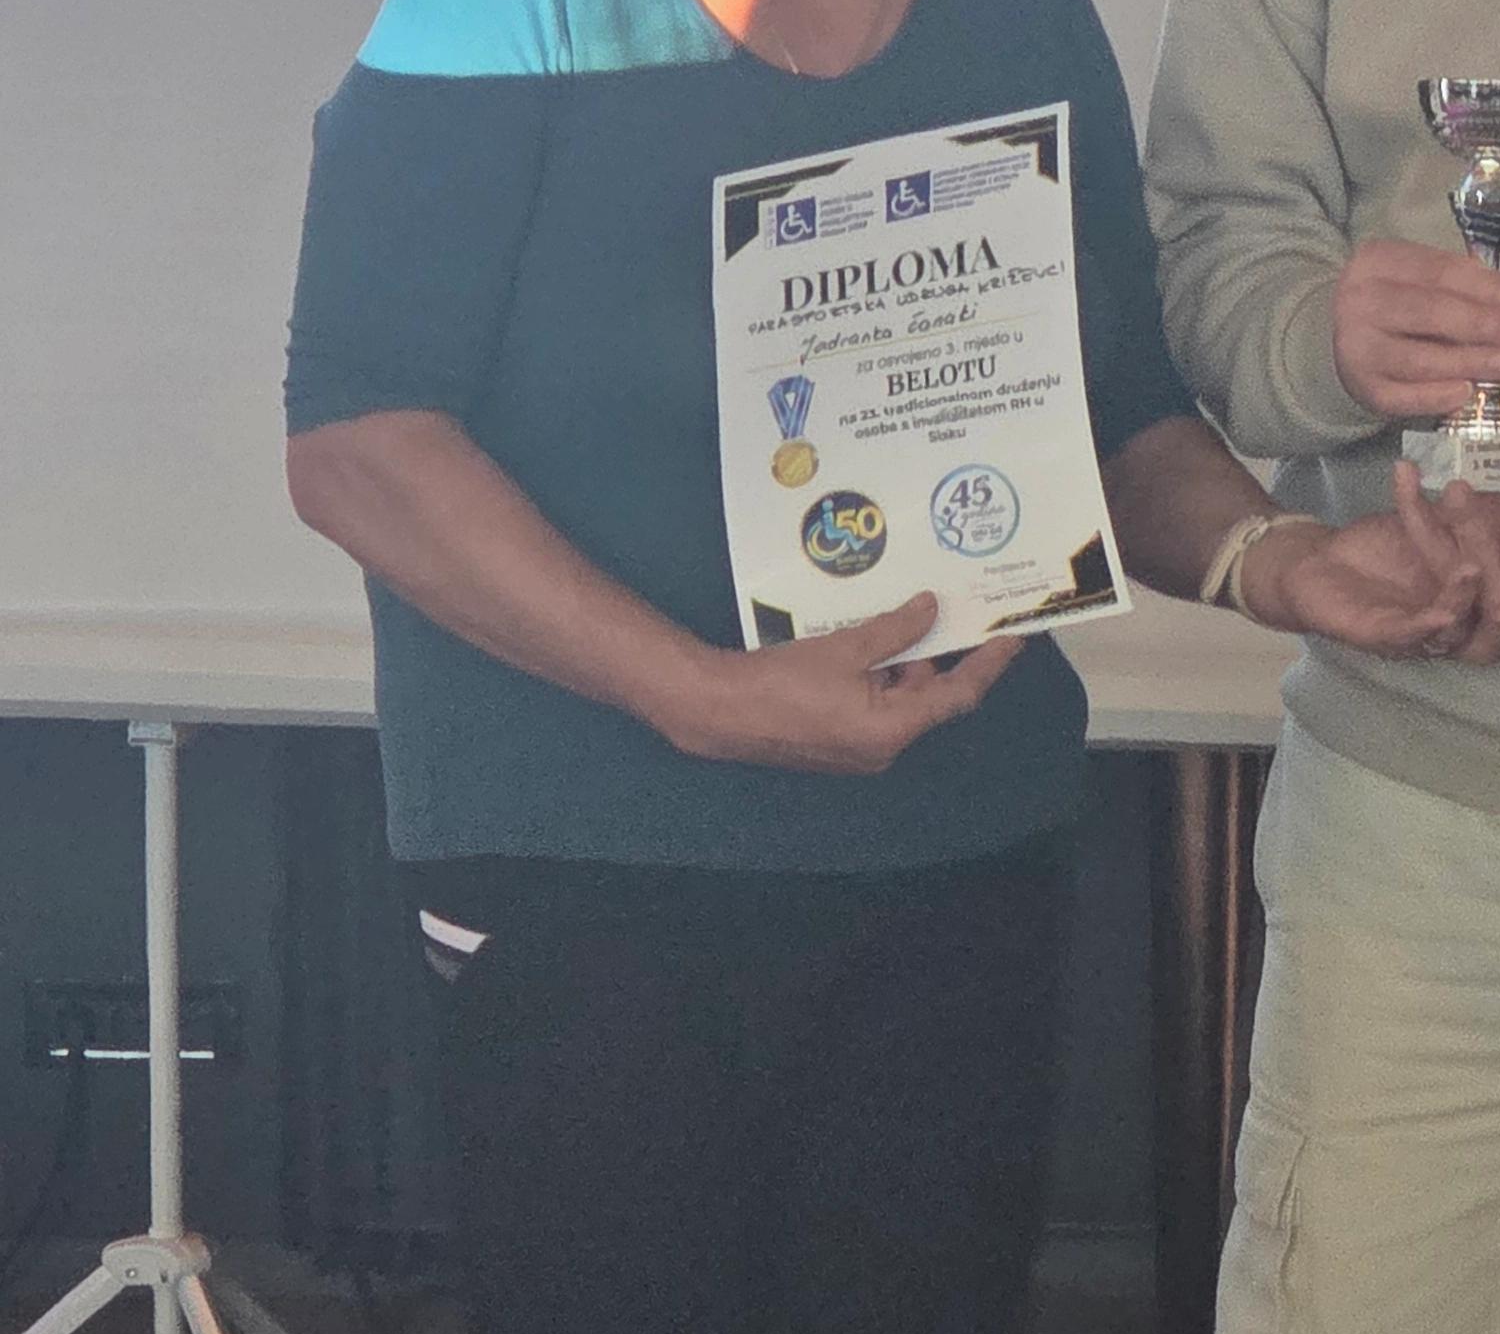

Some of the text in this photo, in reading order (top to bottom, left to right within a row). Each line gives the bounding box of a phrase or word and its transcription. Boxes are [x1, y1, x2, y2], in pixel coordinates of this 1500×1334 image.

[780, 235, 1002, 314] DIPLOMA
[963, 332, 1010, 353] mjesto
[1013, 330, 1024, 344] u
[883, 388, 993, 417] tradicionalnom
[996, 373, 1062, 397] druženju
[886, 354, 997, 398] BELOTU
[854, 423, 899, 440] osoba
[912, 402, 1007, 430] invaliditetom
[1010, 396, 1032, 411] RH
[1034, 395, 1045, 407] u
[949, 474, 994, 510] 45
[836, 505, 885, 541] 50
